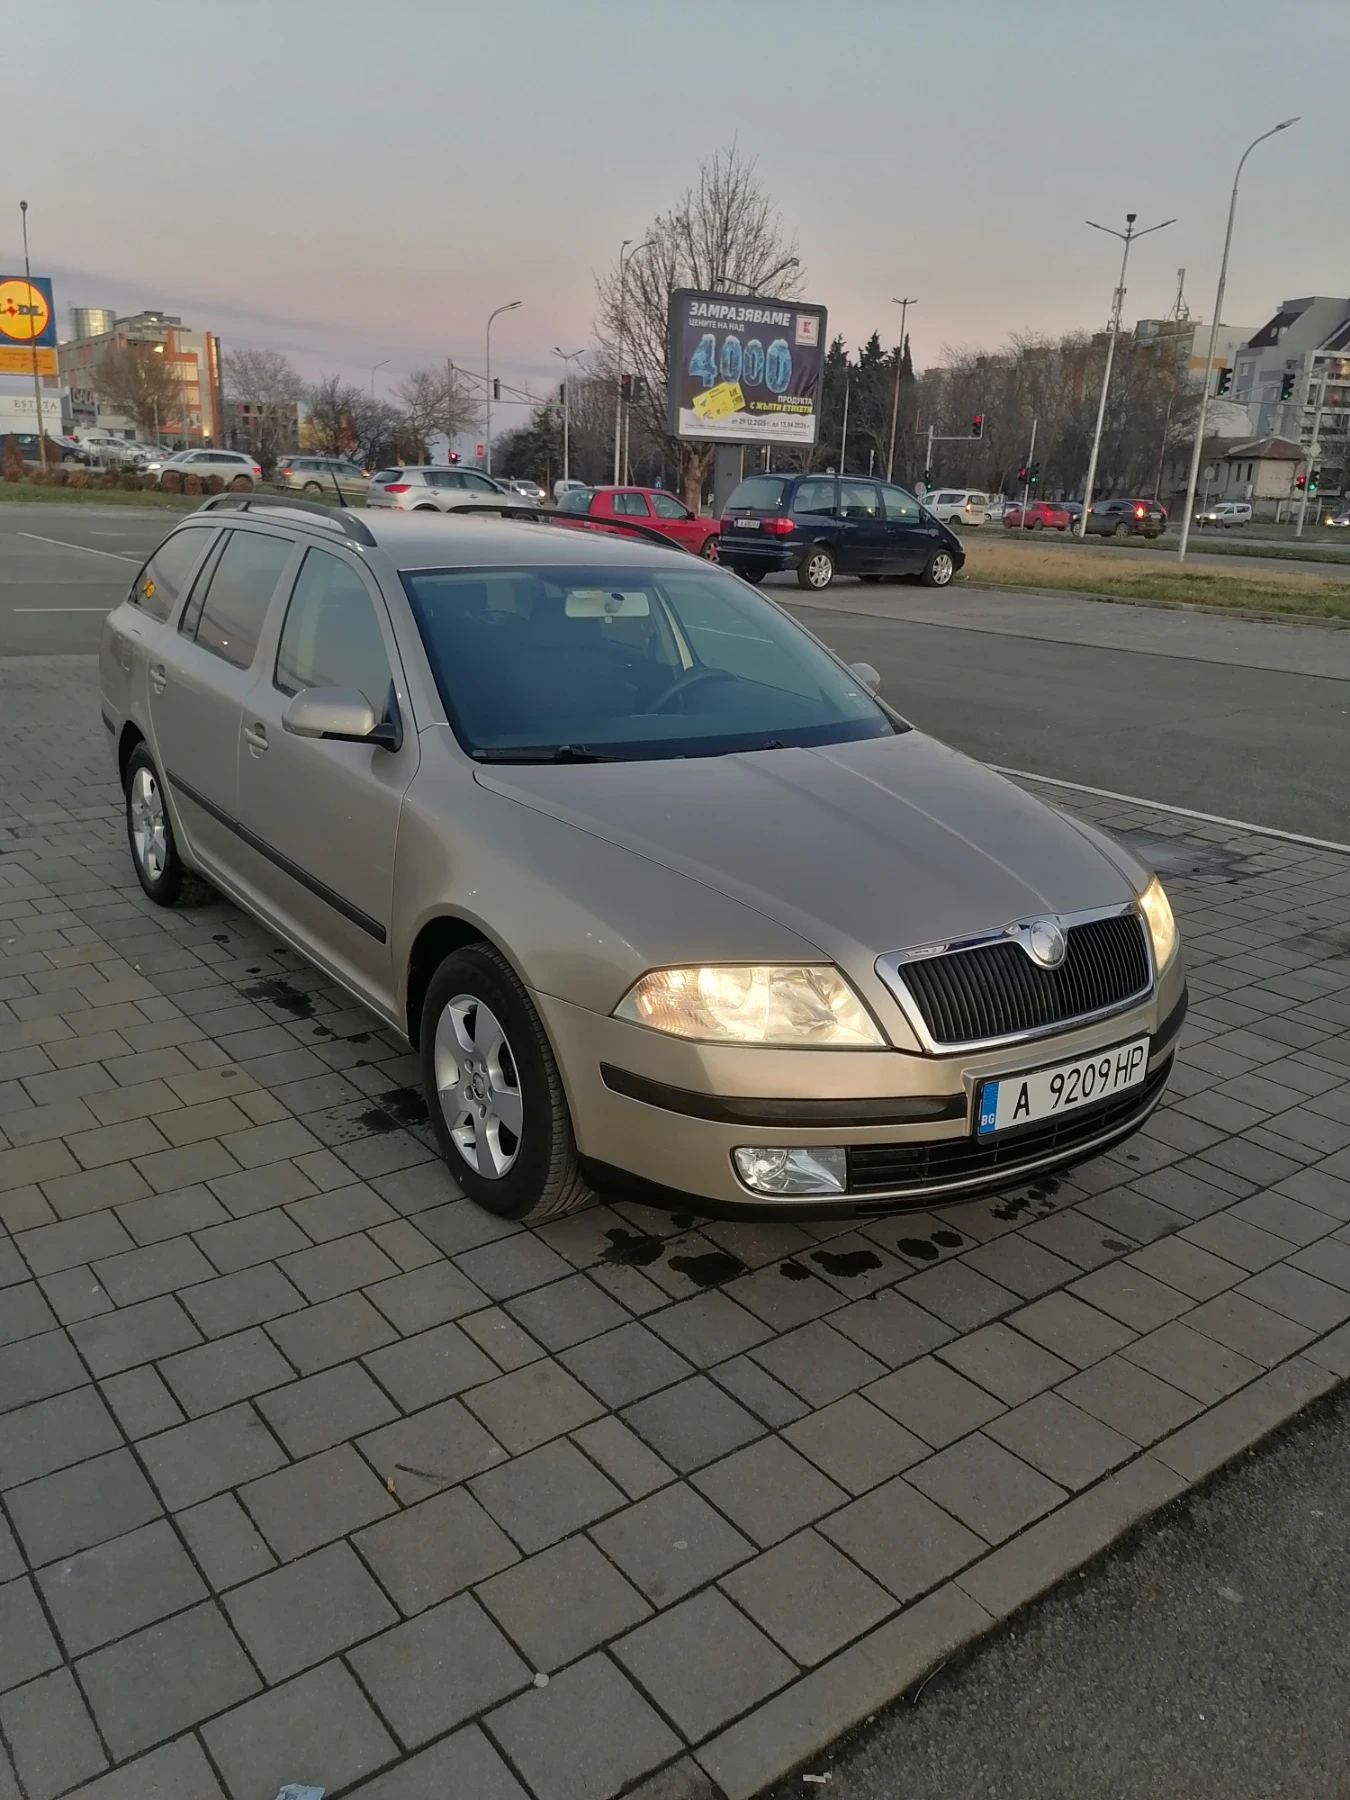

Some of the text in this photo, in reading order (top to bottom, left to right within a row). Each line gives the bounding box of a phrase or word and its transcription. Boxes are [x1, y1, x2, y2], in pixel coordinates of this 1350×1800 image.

[689, 302, 791, 326] ЗАМРАЗЯВАМЕ
[689, 319, 744, 332] ЦЕНИТЕ НА НАД
[689, 334, 792, 393] 4000
[14, 400, 57, 409] ESTTA
[778, 396, 813, 405] ПРОДУКТА
[756, 402, 782, 411] ЖЪЛТИ
[783, 404, 812, 413] ЕТИКЕТИ
[1012, 1081, 1030, 1120] A
[980, 1113, 995, 1127] BG
